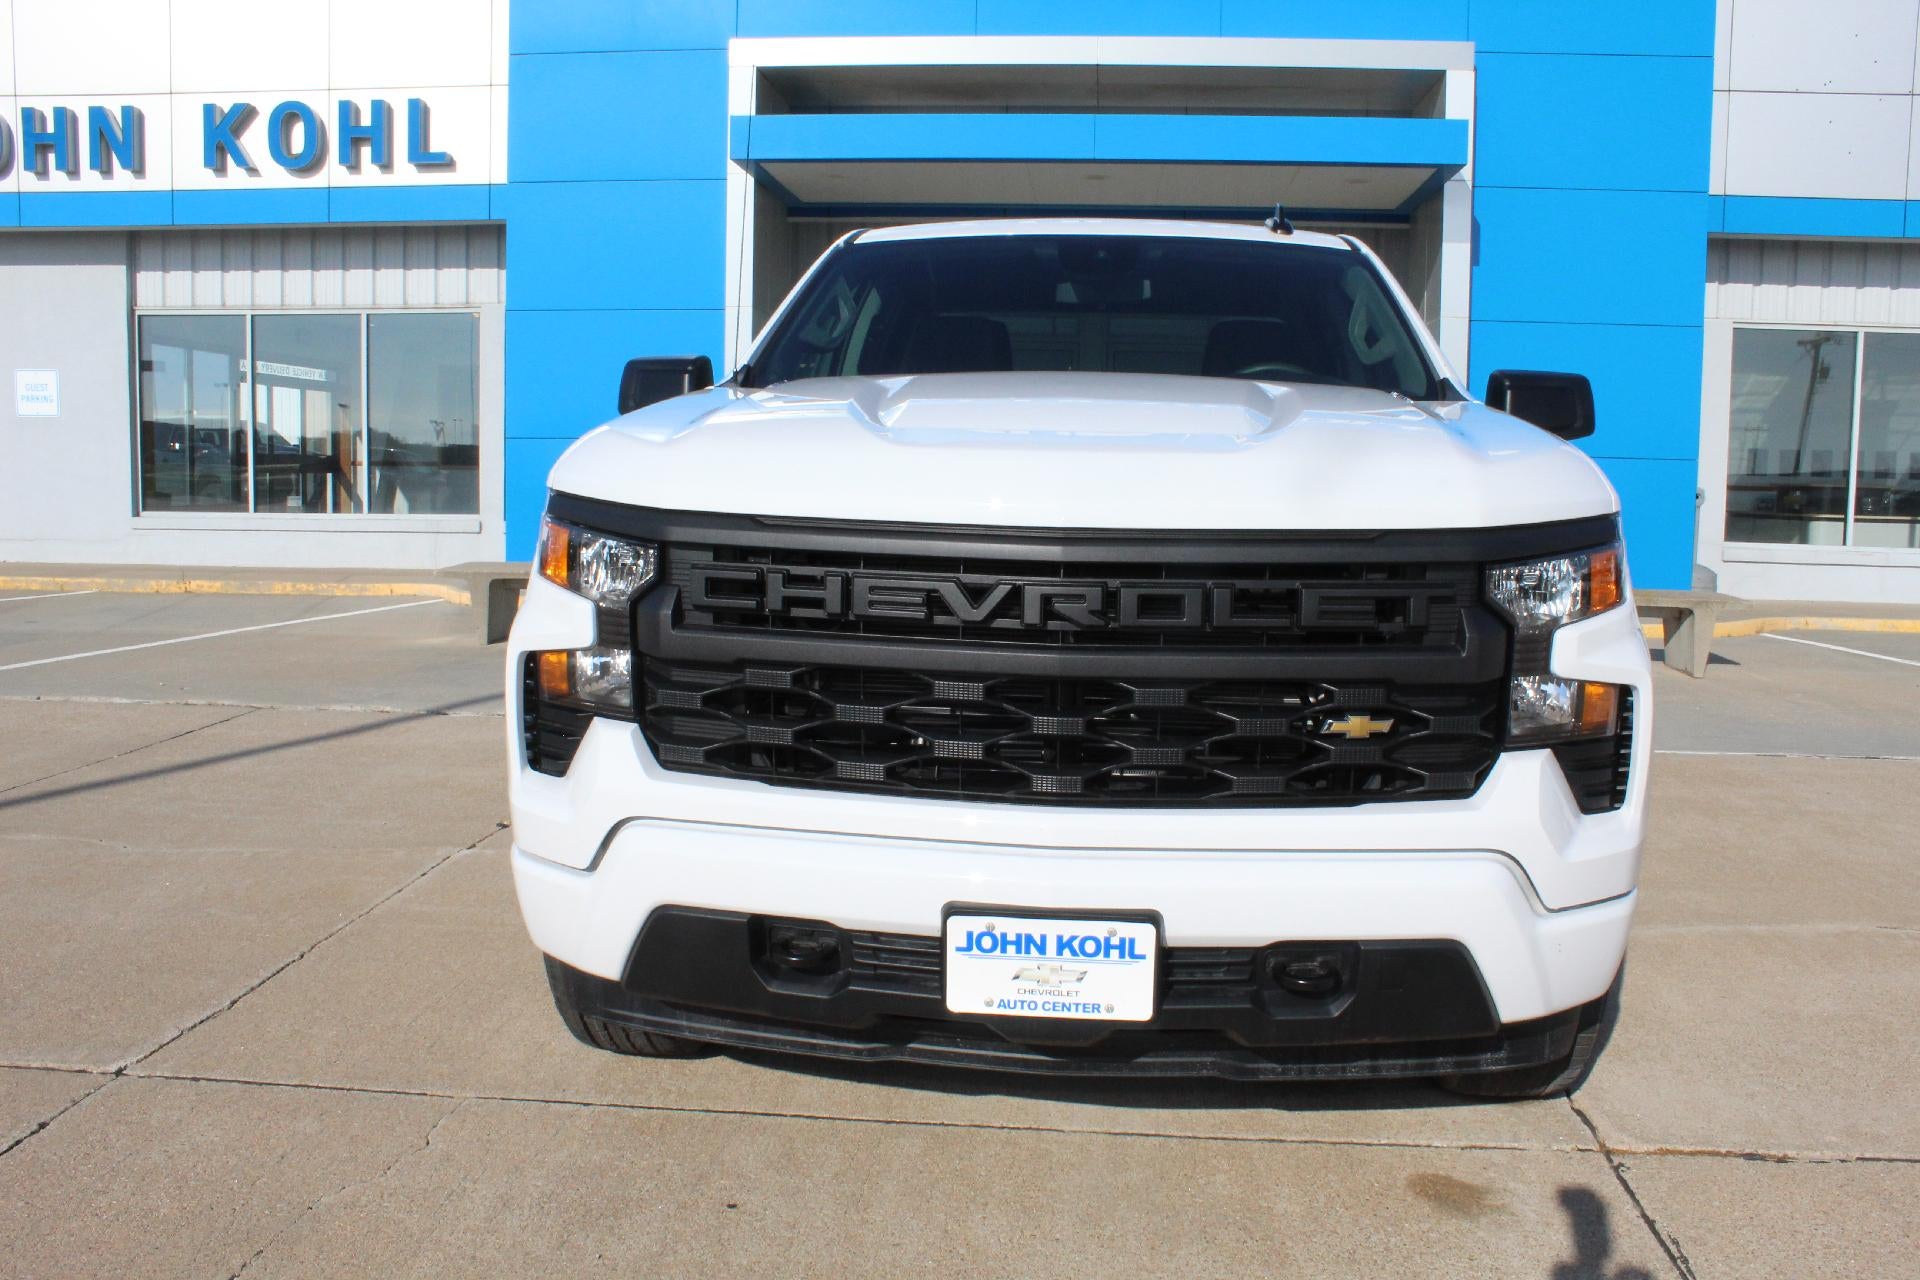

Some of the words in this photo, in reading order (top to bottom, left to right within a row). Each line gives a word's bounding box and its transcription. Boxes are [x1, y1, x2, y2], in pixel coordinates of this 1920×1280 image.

[0, 104, 143, 178] HN
[202, 97, 454, 176] KOHL
[25, 383, 49, 392] GUEST
[20, 394, 54, 404] PARKING
[690, 564, 1457, 632] CHEVROLET
[955, 930, 1047, 956] JOHN
[1056, 934, 1147, 960] KOHL
[1017, 987, 1081, 998] CHEVROLET
[997, 998, 1038, 1011] AUTO
[1041, 1000, 1101, 1014] CENTER
